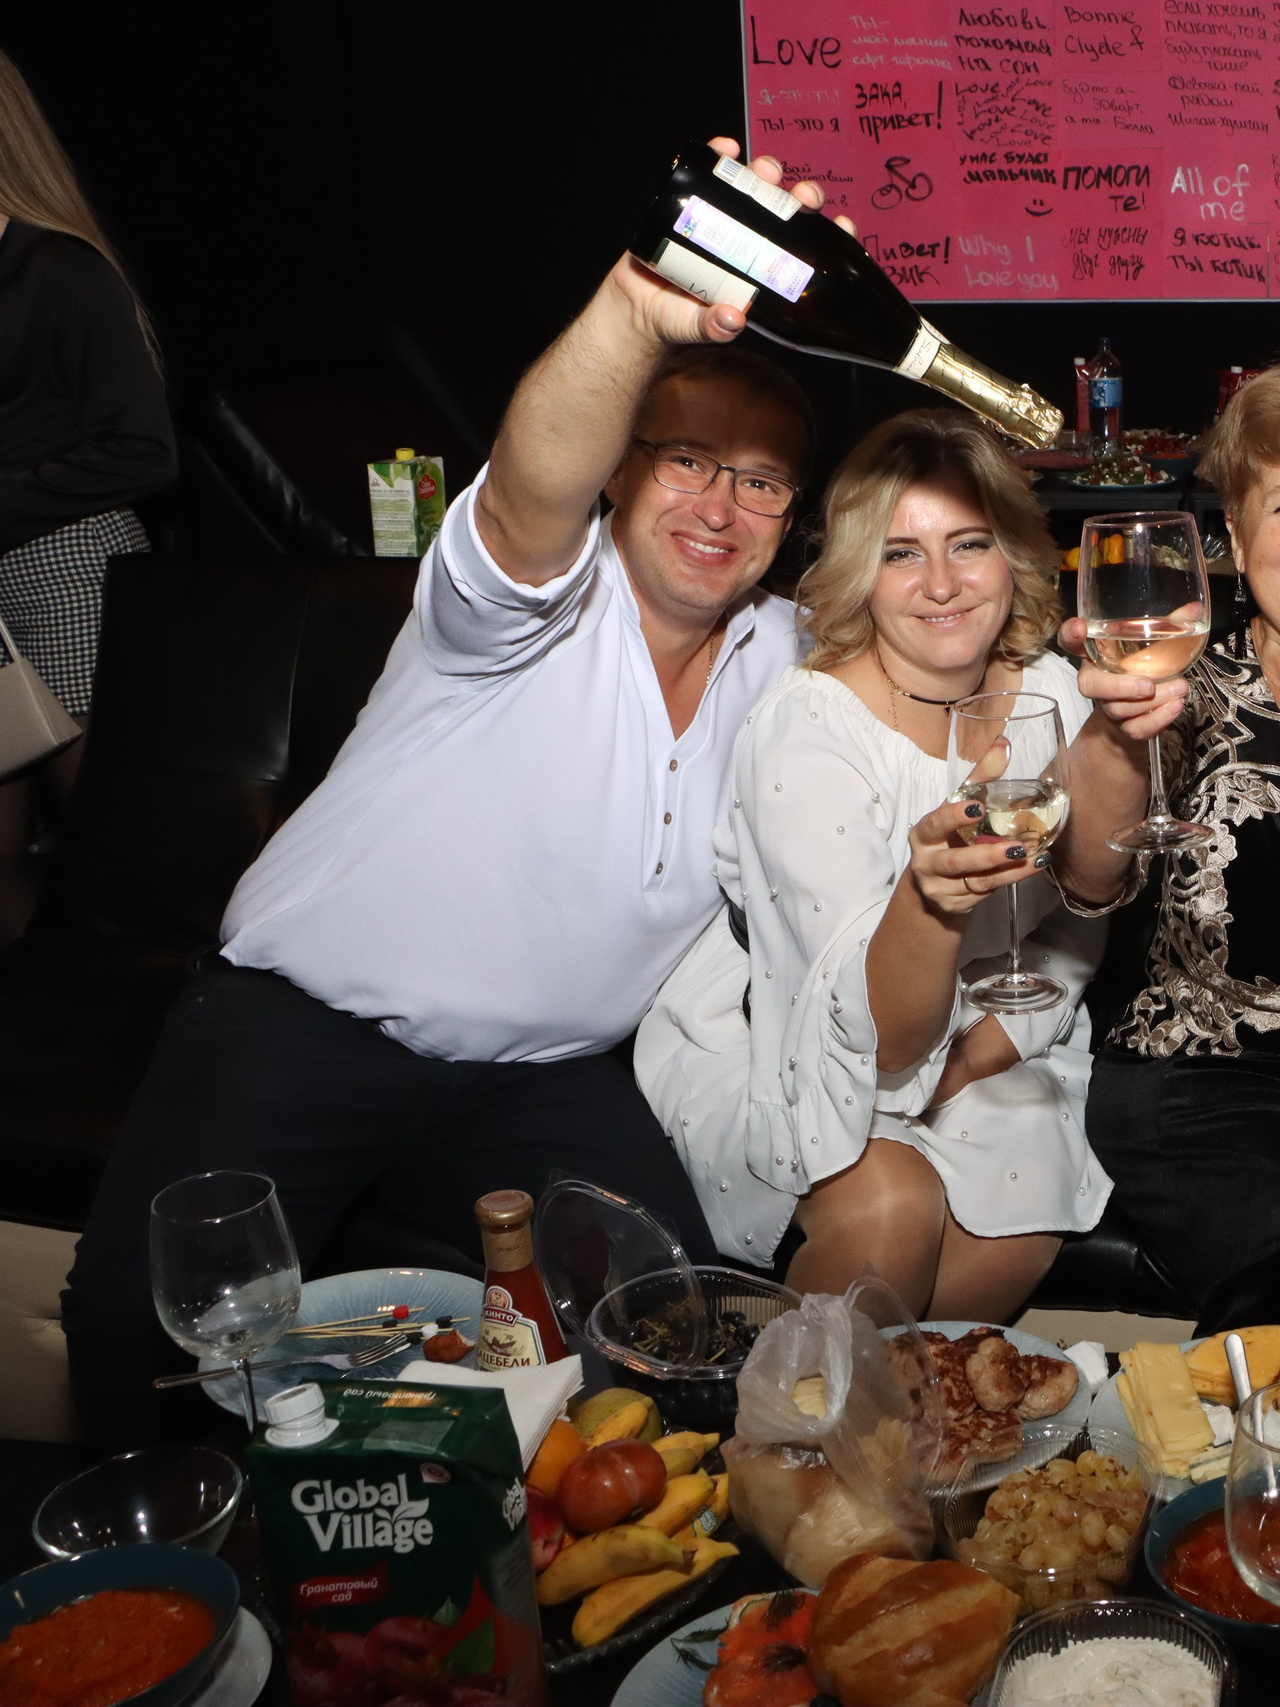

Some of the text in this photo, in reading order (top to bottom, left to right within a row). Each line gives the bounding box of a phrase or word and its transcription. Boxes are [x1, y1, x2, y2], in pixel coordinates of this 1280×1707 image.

[1064, 6, 1137, 25] Bonnie
[750, 15, 842, 68] Love
[1064, 34, 1127, 62] Clyde
[955, 82, 1000, 96] Love
[973, 105, 1016, 119] Love
[1170, 163, 1249, 197] All of
[1200, 202, 1245, 221] me
[958, 235, 1012, 265] Why
[1017, 271, 1059, 293] you
[291, 1473, 429, 1515] Global
[304, 1510, 433, 1553] Village
[300, 1577, 378, 1597] Гранатовый
[332, 1591, 352, 1603] сад
